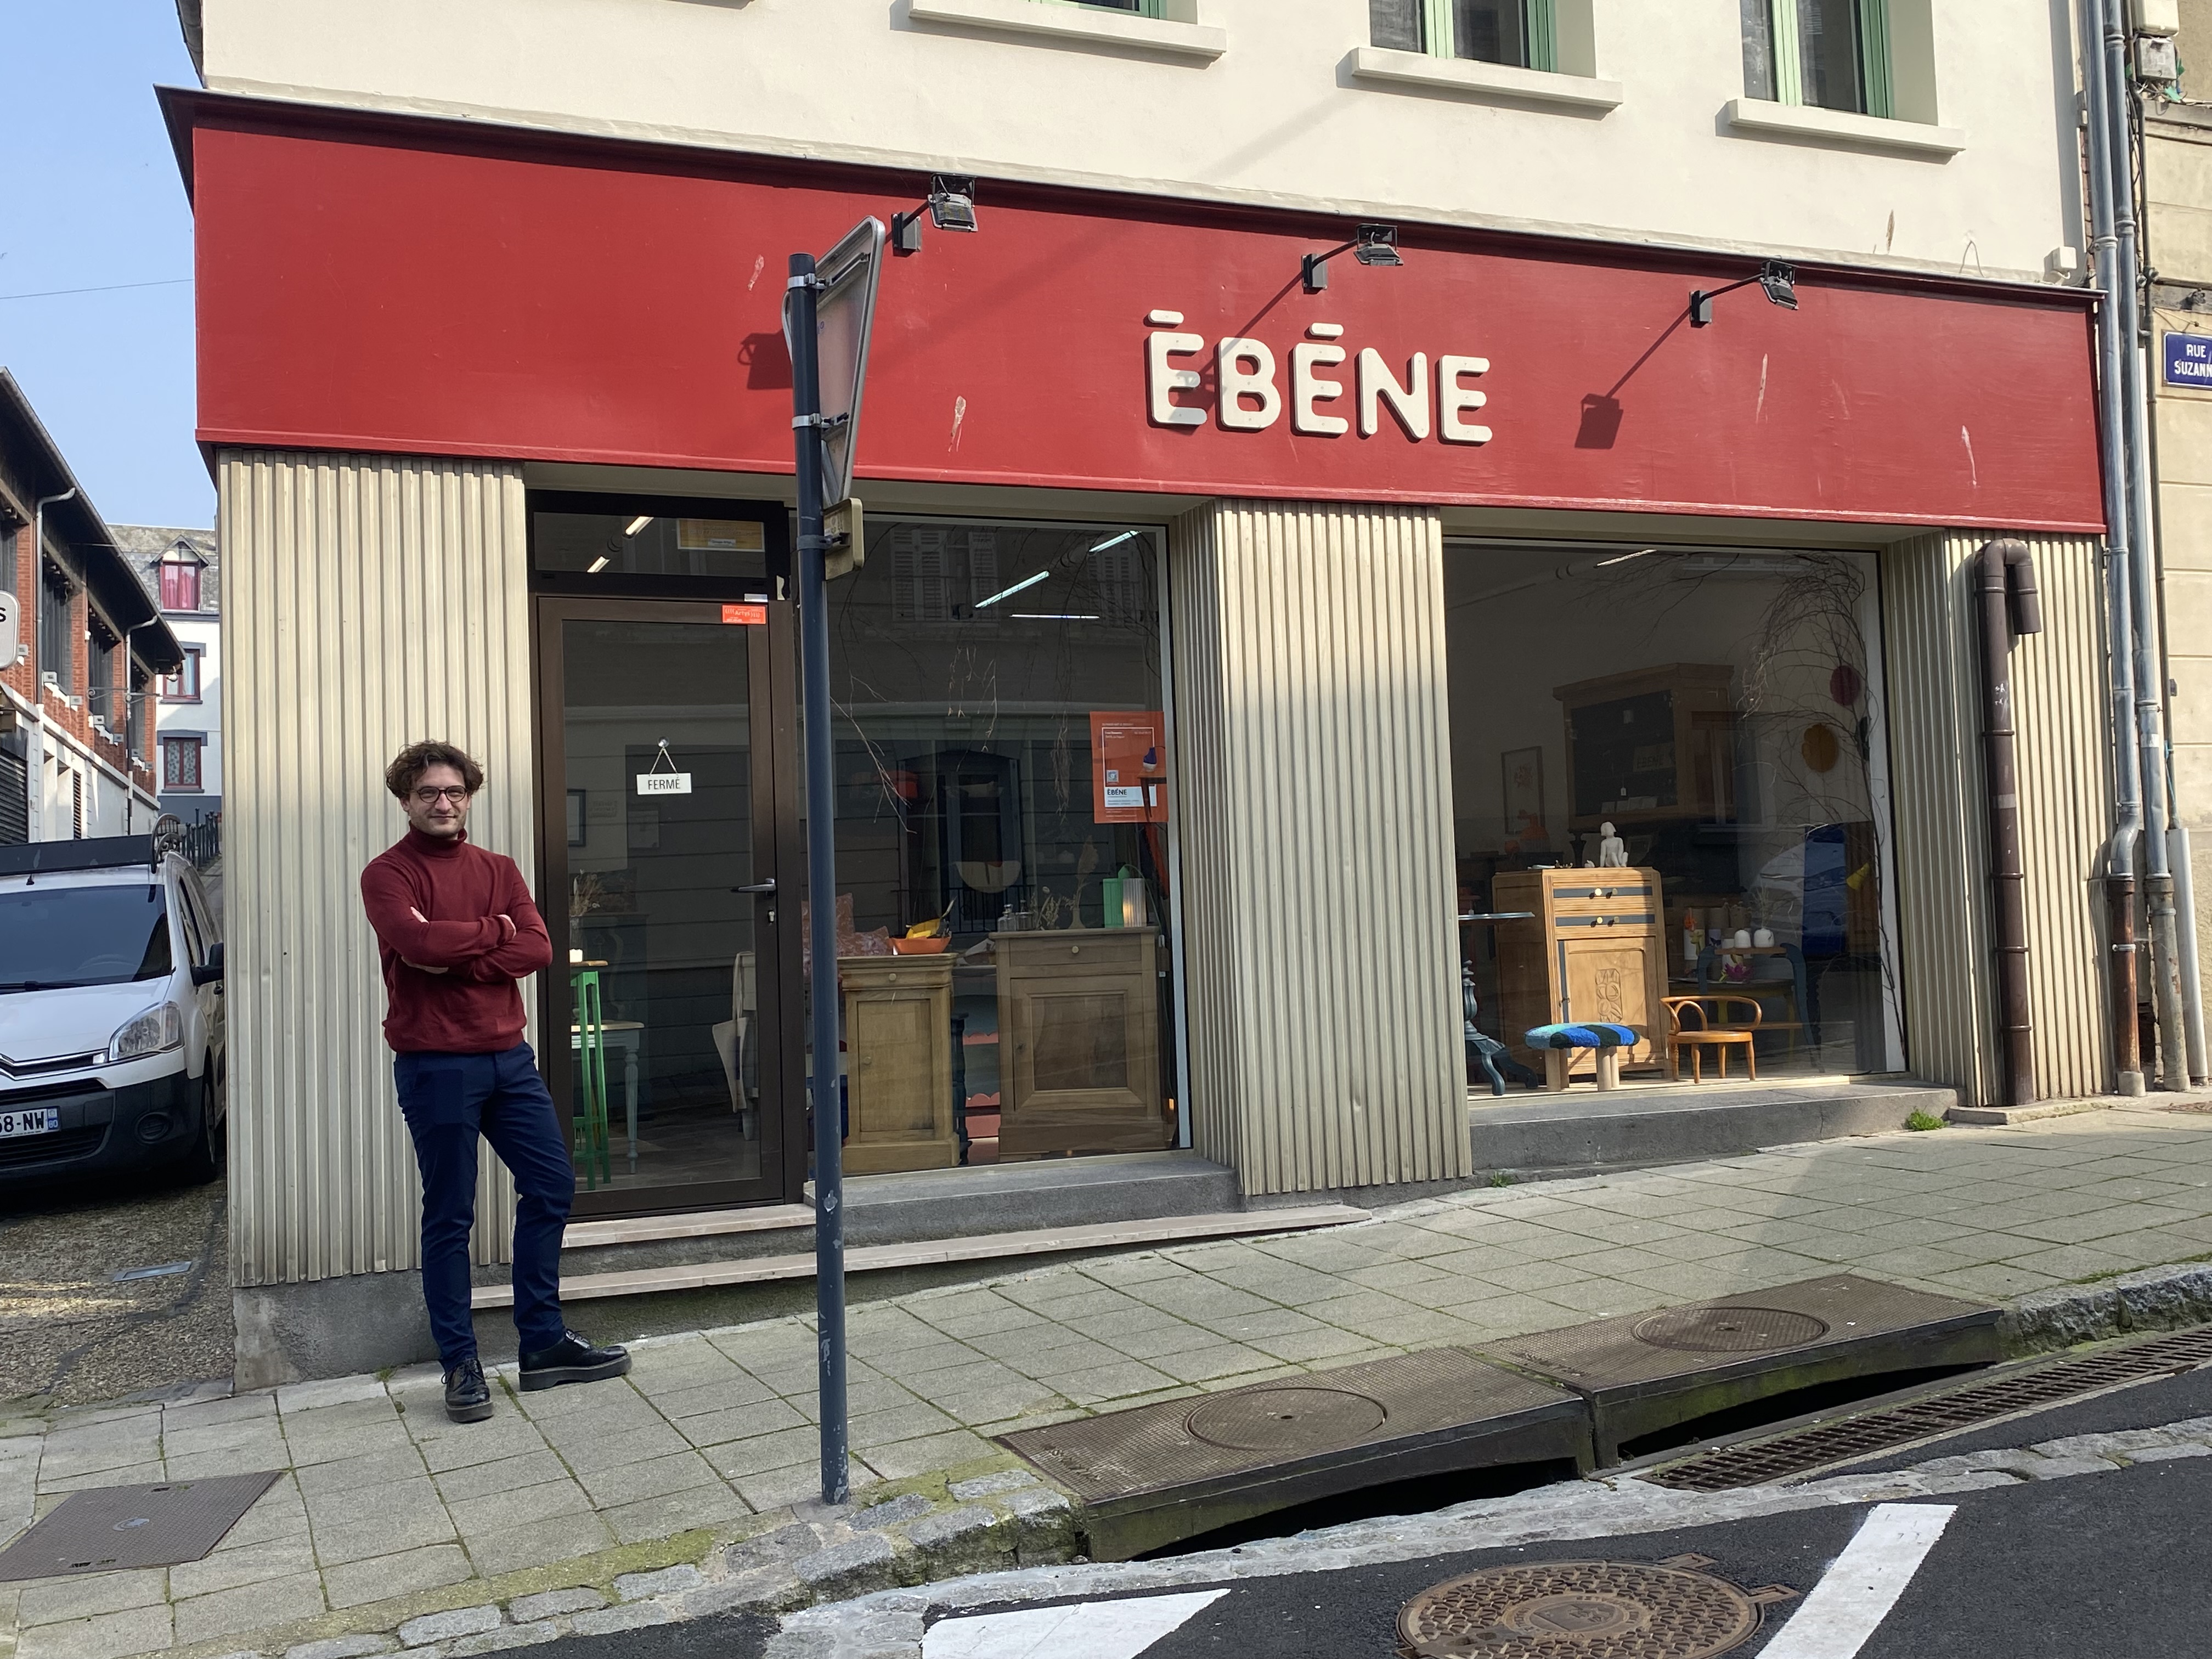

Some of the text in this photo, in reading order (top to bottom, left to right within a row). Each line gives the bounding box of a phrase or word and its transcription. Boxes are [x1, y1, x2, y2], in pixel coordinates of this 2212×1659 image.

[2186, 343, 2207, 358] RUE
[2174, 360, 2212, 378] SUZANN
[648, 777, 681, 790] FERMÉ
